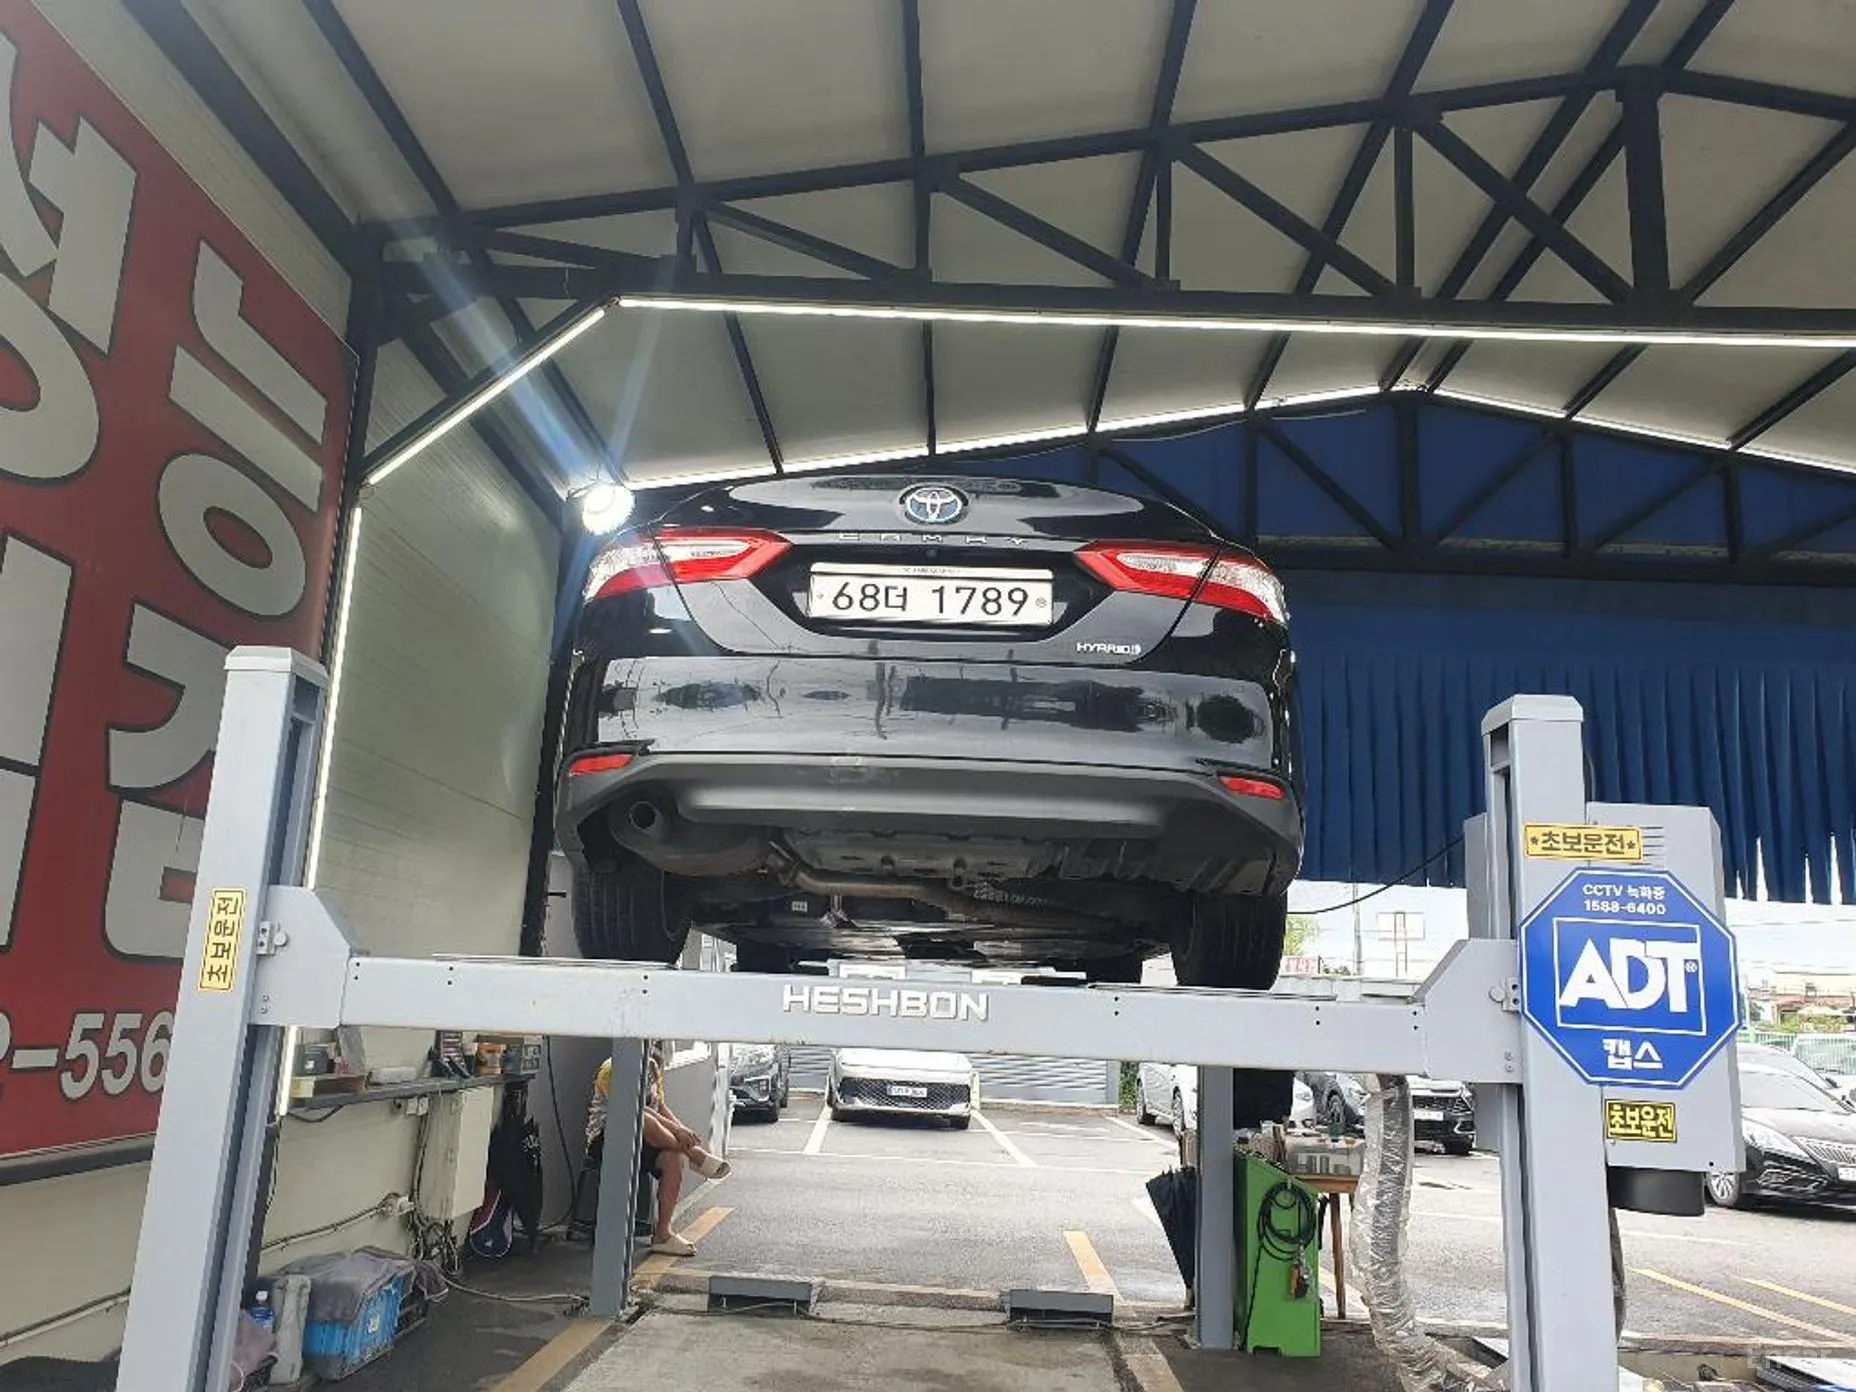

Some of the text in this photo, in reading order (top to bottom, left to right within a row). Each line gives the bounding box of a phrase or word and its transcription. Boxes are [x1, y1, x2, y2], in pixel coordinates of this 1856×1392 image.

[832, 582, 1029, 616] 68더 1789
[1541, 830, 1625, 855] 초보운전
[1583, 884, 1666, 900] CCTV 녹화중
[1584, 900, 1667, 915] 1588-6400
[206, 896, 239, 984] 초보운전
[783, 984, 989, 1021] HESHBON
[1602, 1038, 1663, 1070] 캡스
[1609, 1104, 1674, 1138] 초보운전
